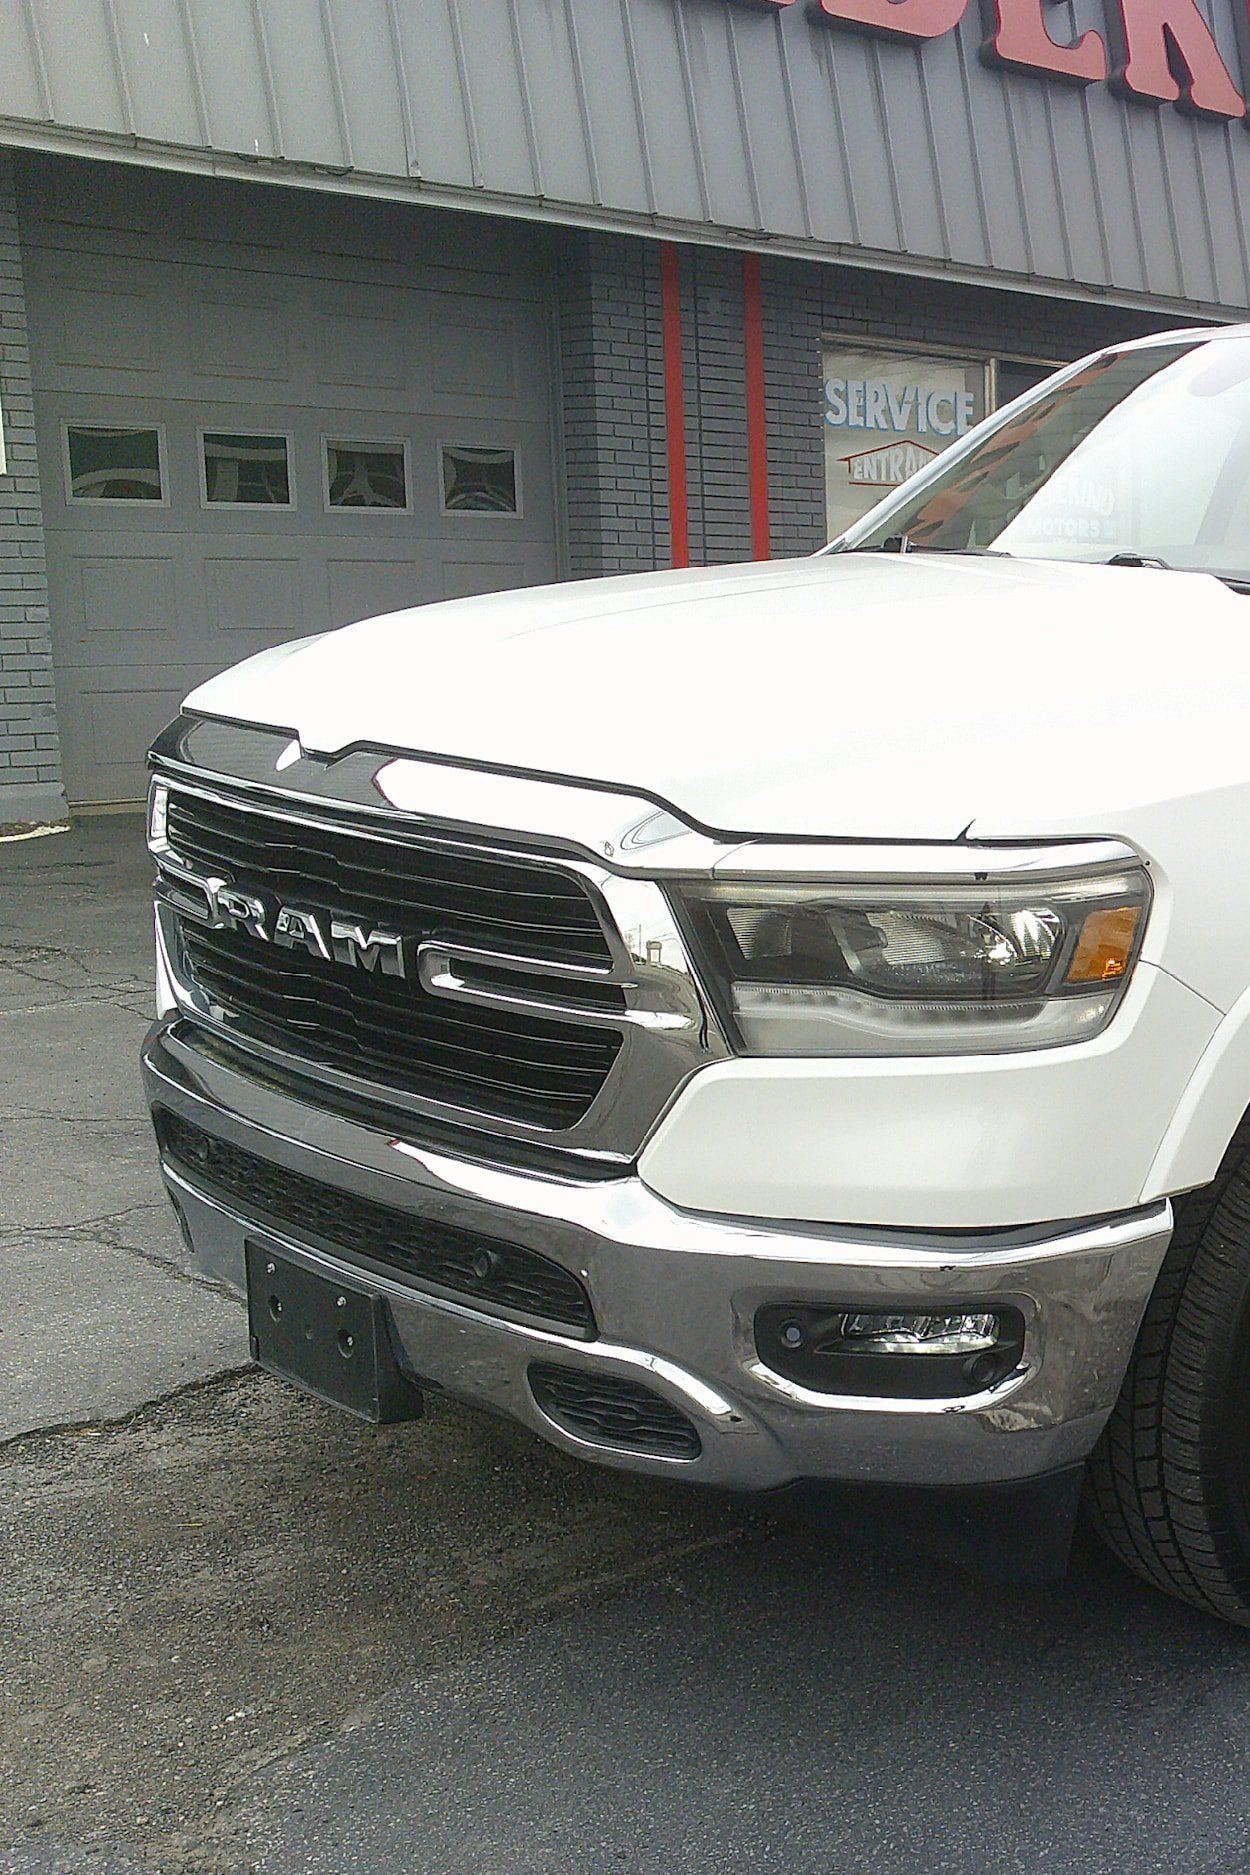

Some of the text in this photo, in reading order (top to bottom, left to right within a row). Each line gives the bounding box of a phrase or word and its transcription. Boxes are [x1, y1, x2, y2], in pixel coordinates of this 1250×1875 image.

[825, 378, 974, 436] SERVICE
[853, 446, 930, 483] ENTRA
[1026, 518, 1100, 538] MOTORS
[218, 885, 406, 980] RAM
